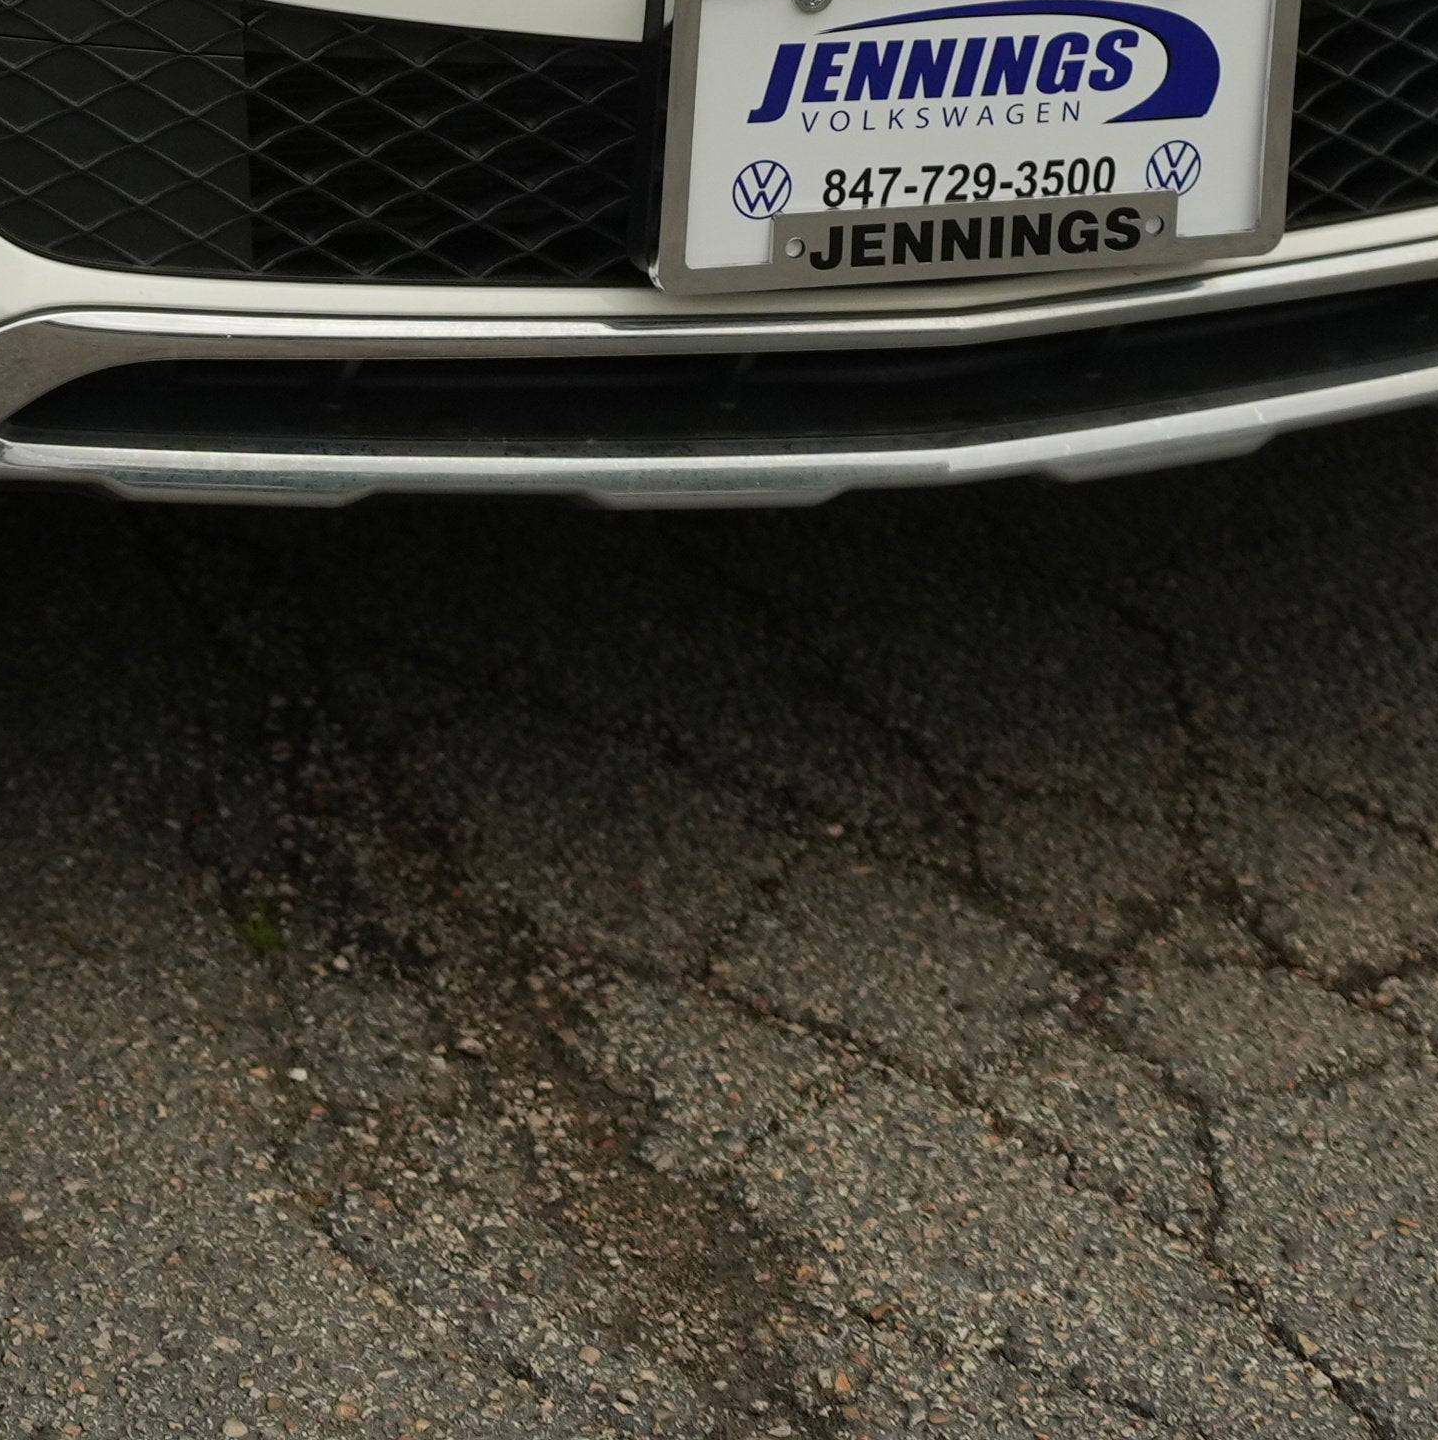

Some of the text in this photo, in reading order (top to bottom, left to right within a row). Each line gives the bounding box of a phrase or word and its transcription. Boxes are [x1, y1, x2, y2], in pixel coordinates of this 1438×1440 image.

[747, 29, 1139, 123] JENNINGS
[802, 100, 1080, 132] VOLKSWAGEN
[822, 156, 1115, 208] 847-729-3500
[810, 207, 1141, 270] JENNINGS
